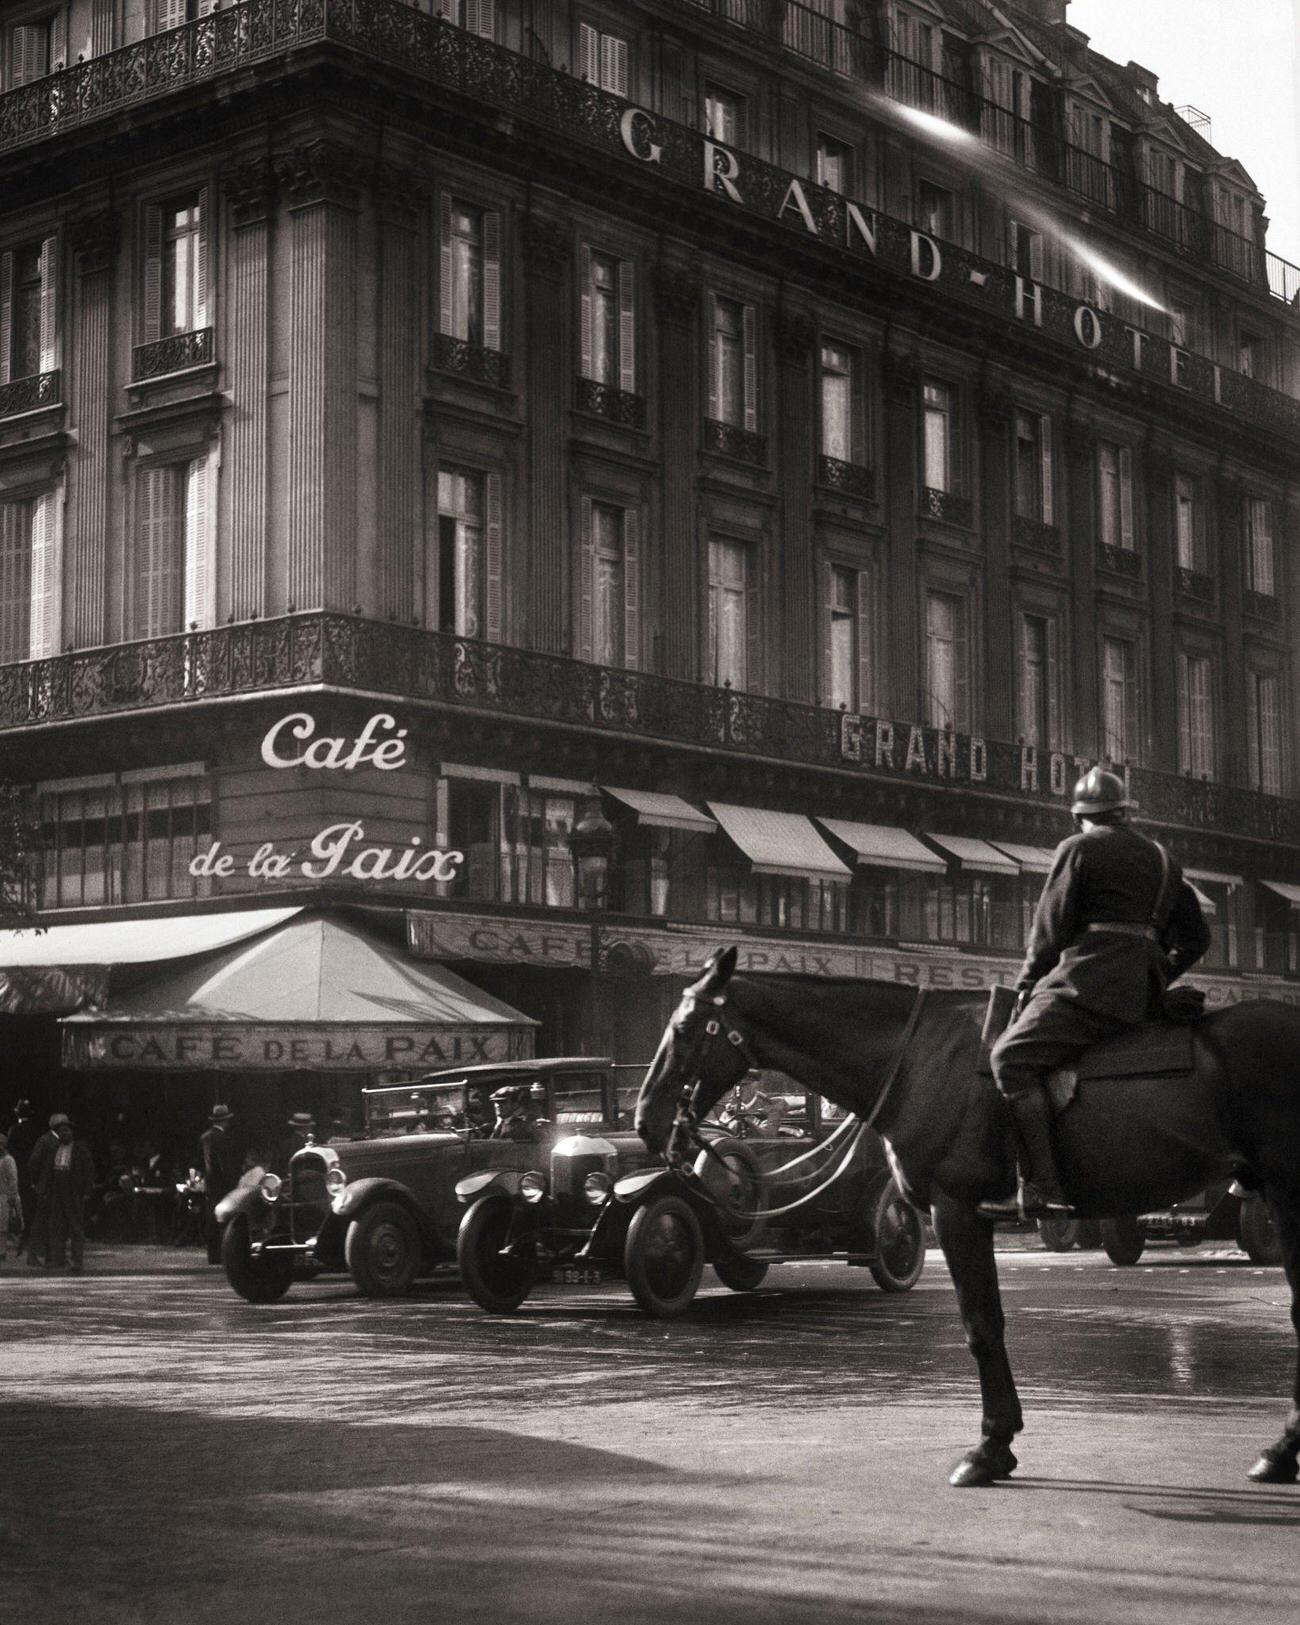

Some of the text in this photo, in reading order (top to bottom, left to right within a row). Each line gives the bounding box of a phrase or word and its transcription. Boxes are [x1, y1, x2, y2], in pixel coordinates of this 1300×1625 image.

[261, 713, 407, 771] Café
[841, 713, 988, 782] GRAND
[189, 820, 464, 882] de la Paix
[747, 952, 833, 976] PAIX
[109, 1034, 494, 1061] CAFE DE LA PAIX
